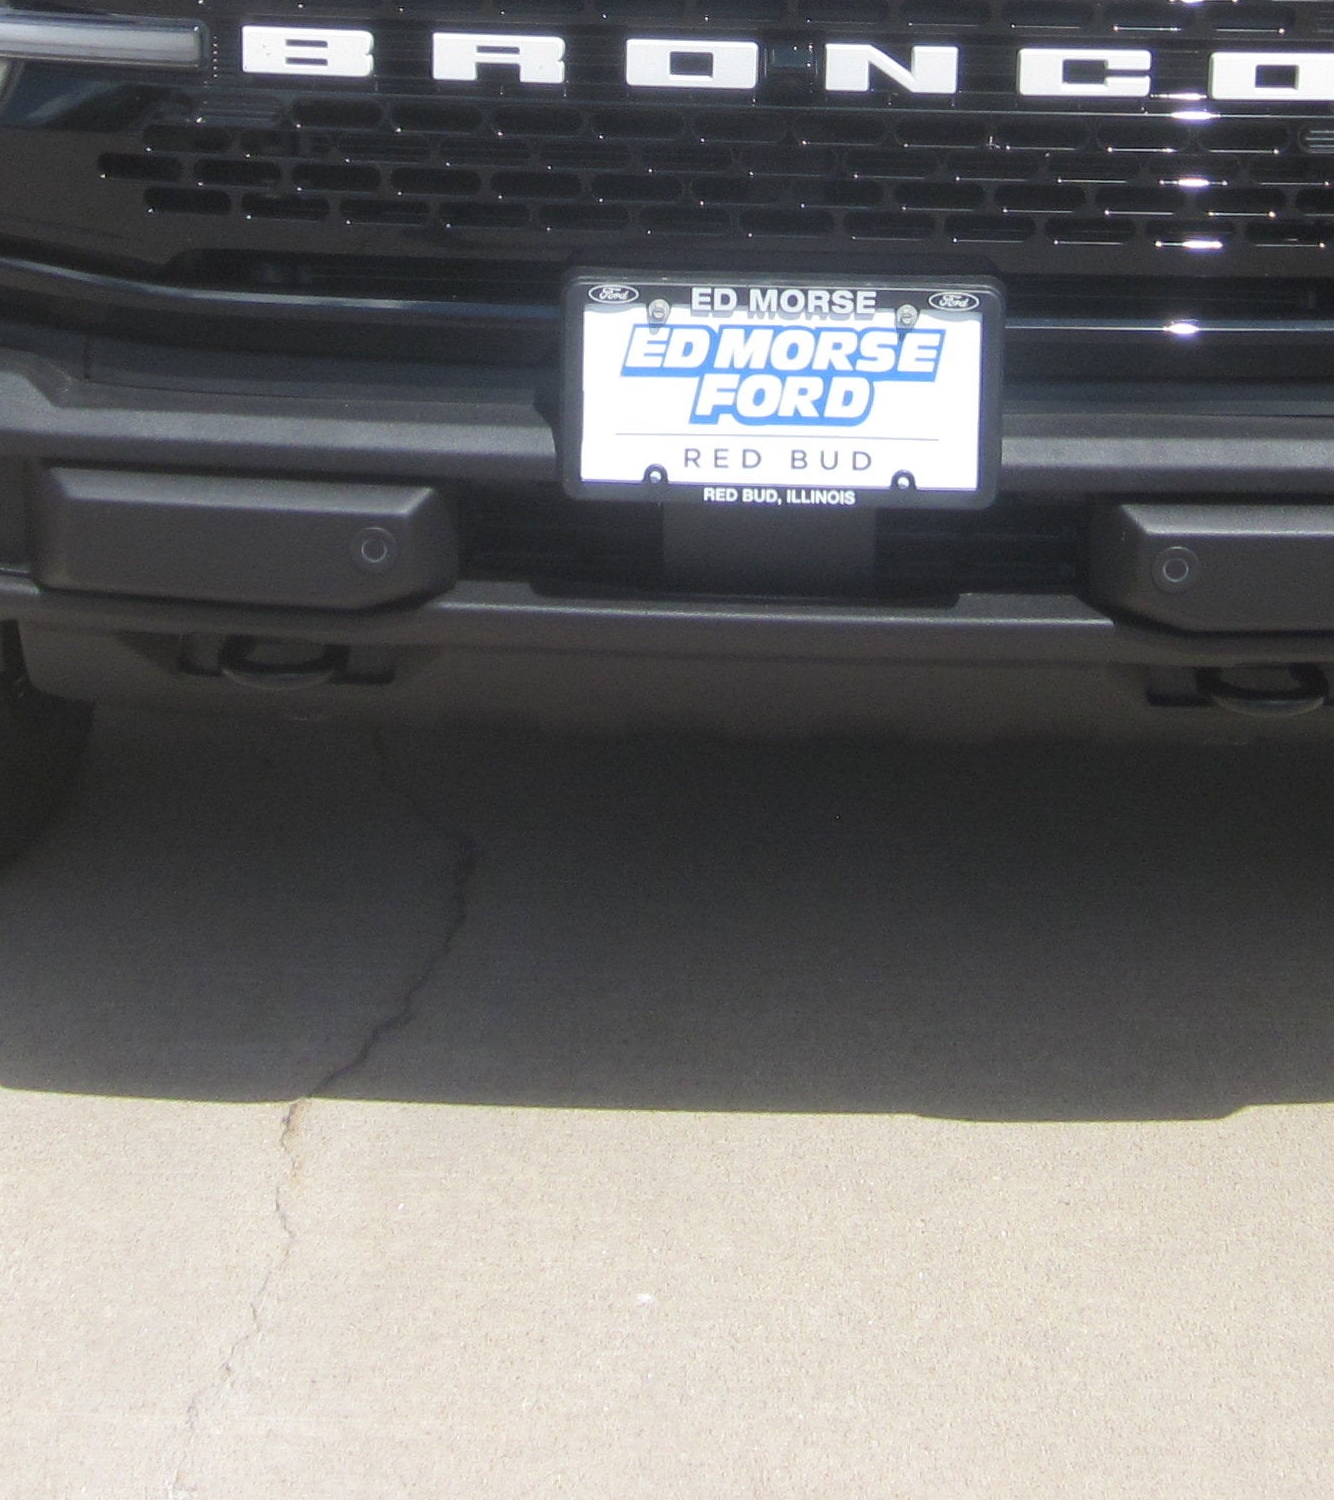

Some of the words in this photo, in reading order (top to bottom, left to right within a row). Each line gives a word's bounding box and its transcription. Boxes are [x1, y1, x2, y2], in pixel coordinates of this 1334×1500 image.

[598, 287, 629, 301] Ford
[691, 287, 738, 311] ED
[749, 289, 877, 315] MORSE
[938, 294, 969, 308] Ford
[624, 327, 711, 369] ED
[713, 328, 942, 374] MORSE
[695, 373, 871, 420] FORD
[683, 448, 762, 469] RED
[790, 449, 873, 471] BUD
[703, 487, 738, 502] RED
[742, 488, 782, 506] BUD,
[786, 489, 856, 505] ILLINOIS
